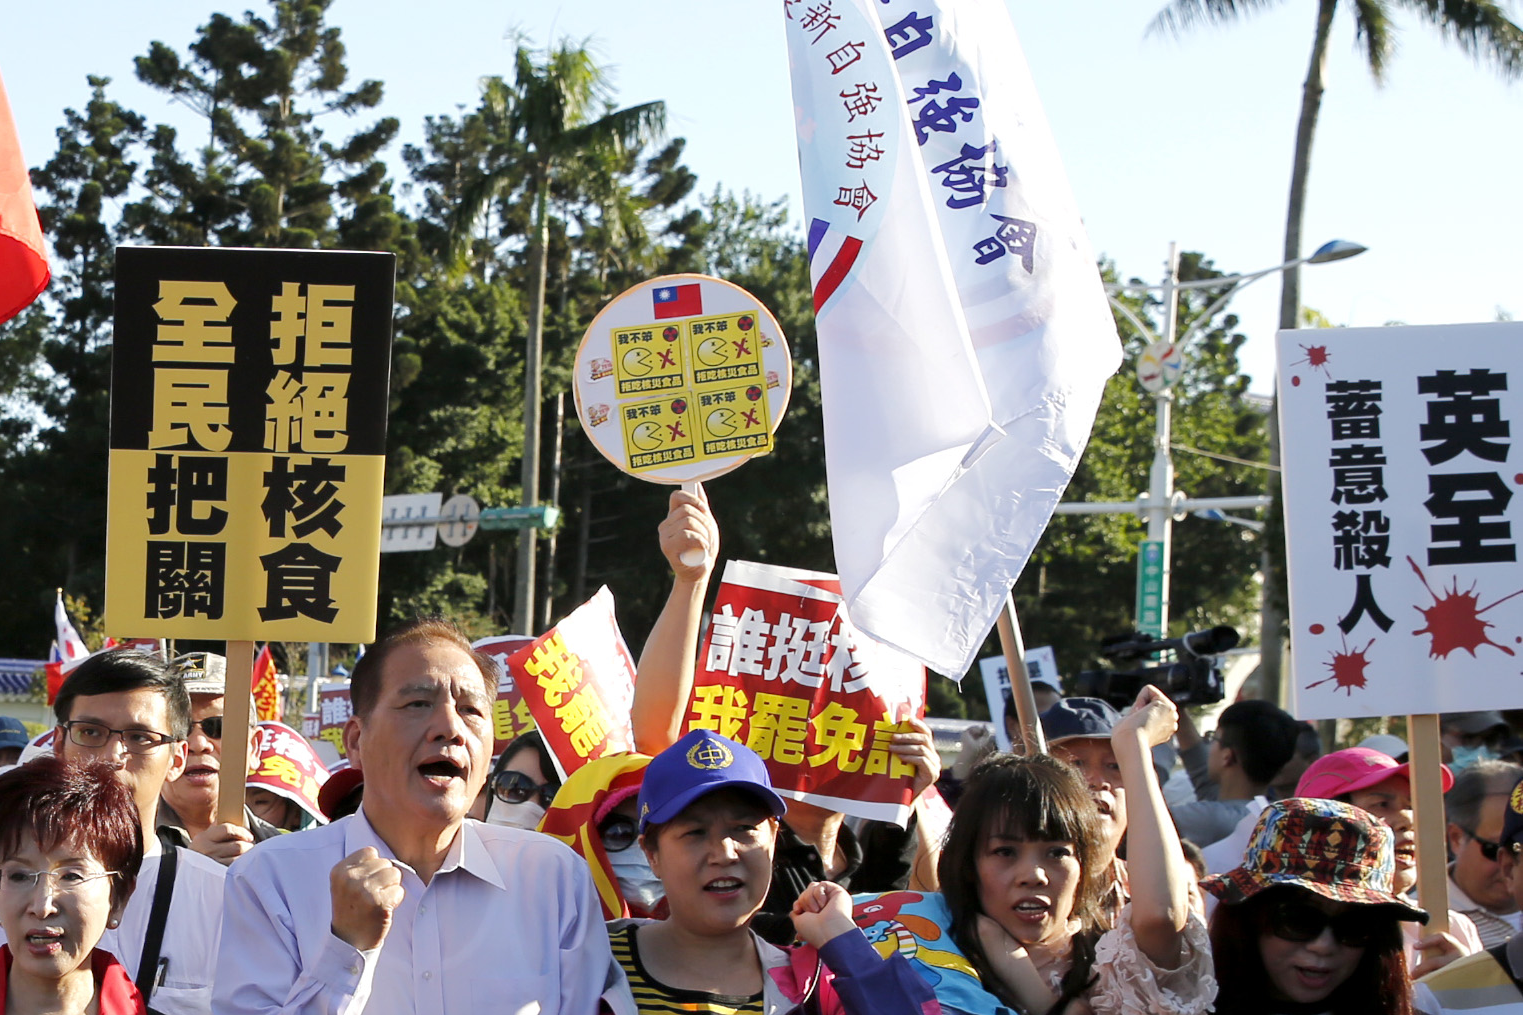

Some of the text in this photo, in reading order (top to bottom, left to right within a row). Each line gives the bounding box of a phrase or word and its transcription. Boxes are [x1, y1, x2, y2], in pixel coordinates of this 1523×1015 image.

[784, 0, 885, 222] 新自強協會
[144, 280, 237, 620] 全民把關
[258, 282, 356, 623] 拒絕核食
[1326, 380, 1395, 634] 蓄意殺人
[1418, 368, 1517, 566] 英全
[524, 631, 616, 764] 我罷
